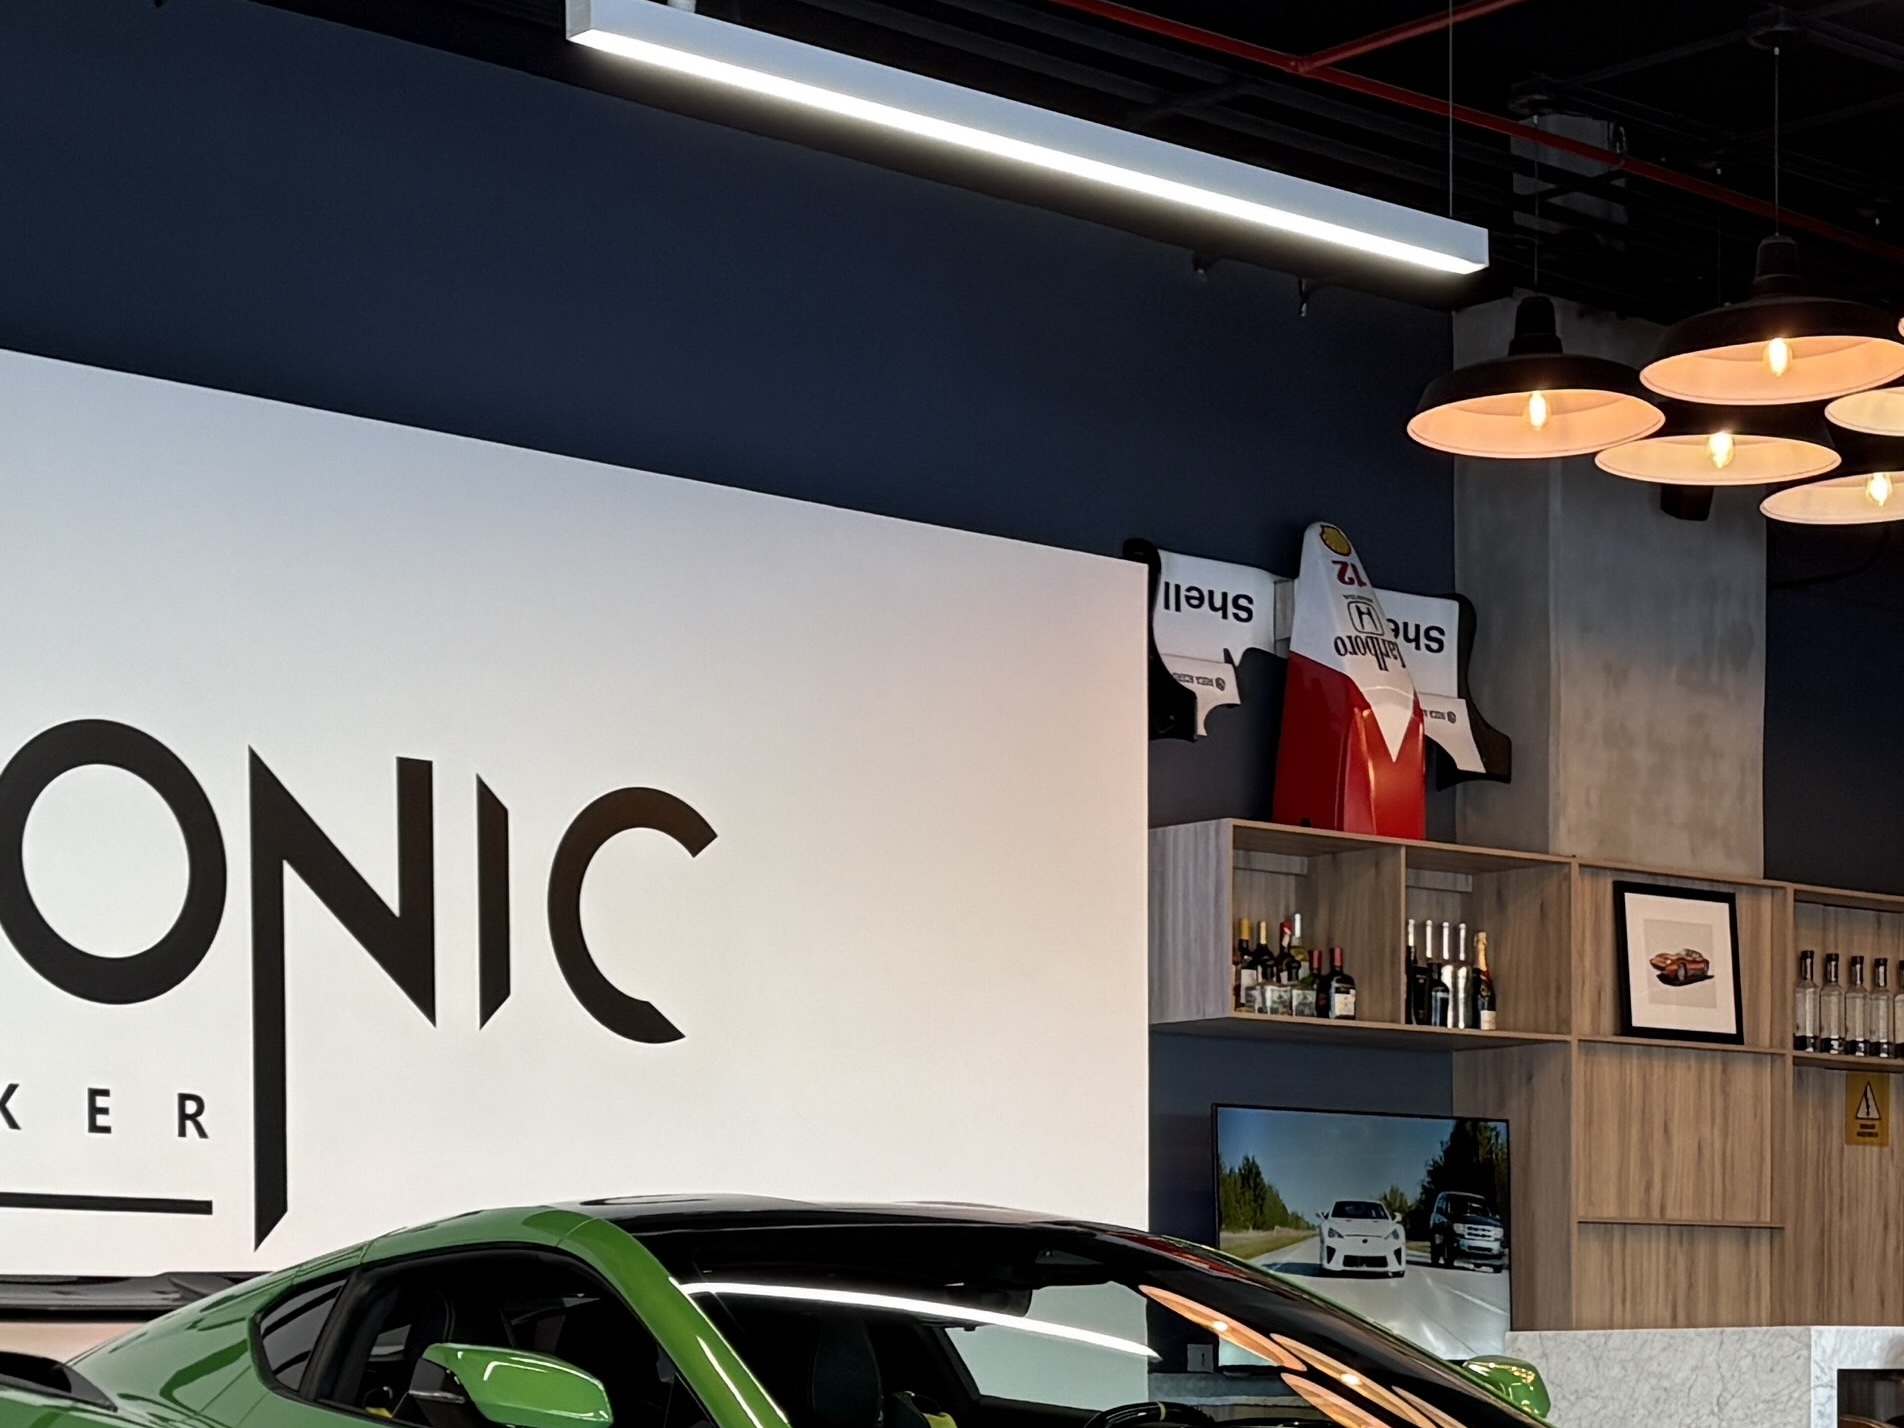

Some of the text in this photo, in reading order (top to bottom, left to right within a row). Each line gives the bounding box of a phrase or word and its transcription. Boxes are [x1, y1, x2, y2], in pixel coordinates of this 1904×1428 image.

[1331, 560, 1367, 587] 12
[1164, 581, 1254, 623] Shell
[1387, 618, 1446, 654] She
